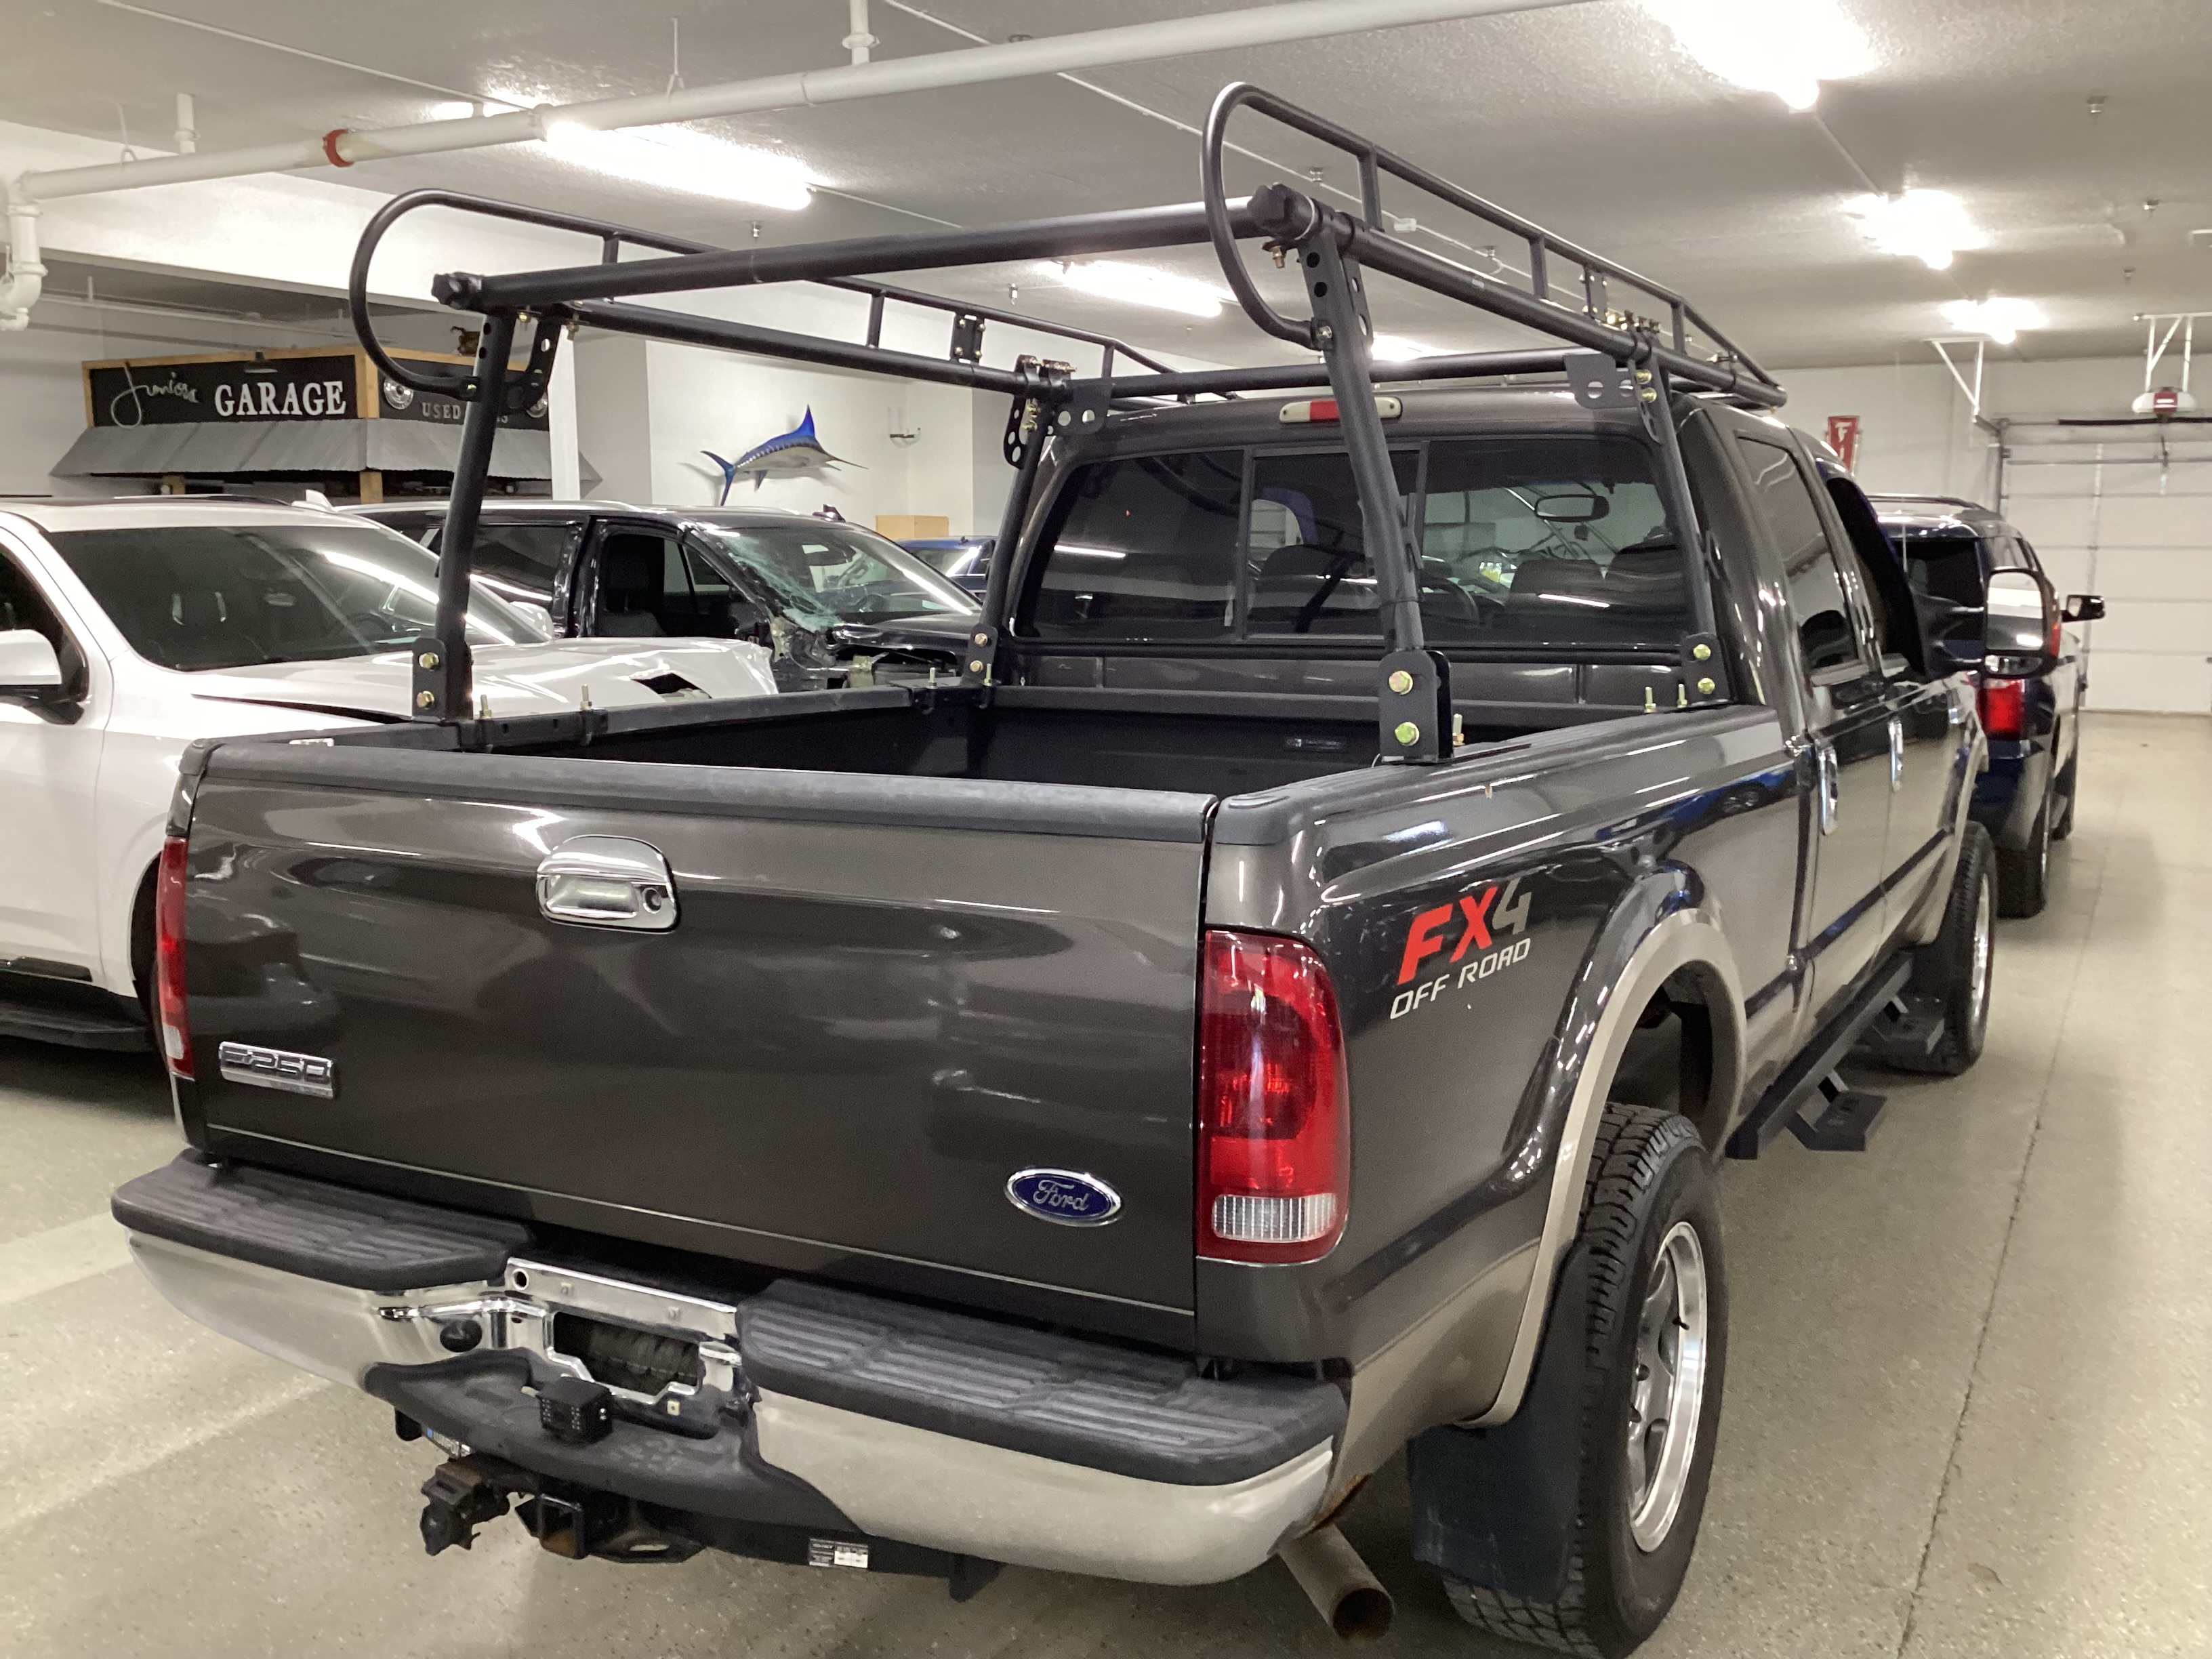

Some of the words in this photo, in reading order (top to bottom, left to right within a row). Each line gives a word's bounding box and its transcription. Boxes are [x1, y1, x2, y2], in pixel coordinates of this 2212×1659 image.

[215, 381, 346, 416] GARAGE
[422, 403, 461, 419] USED
[1397, 877, 1532, 985] FX4
[1390, 973, 1450, 1019] OFF
[1458, 938, 1531, 989] ROAD
[1033, 1179, 1088, 1211] Ford
